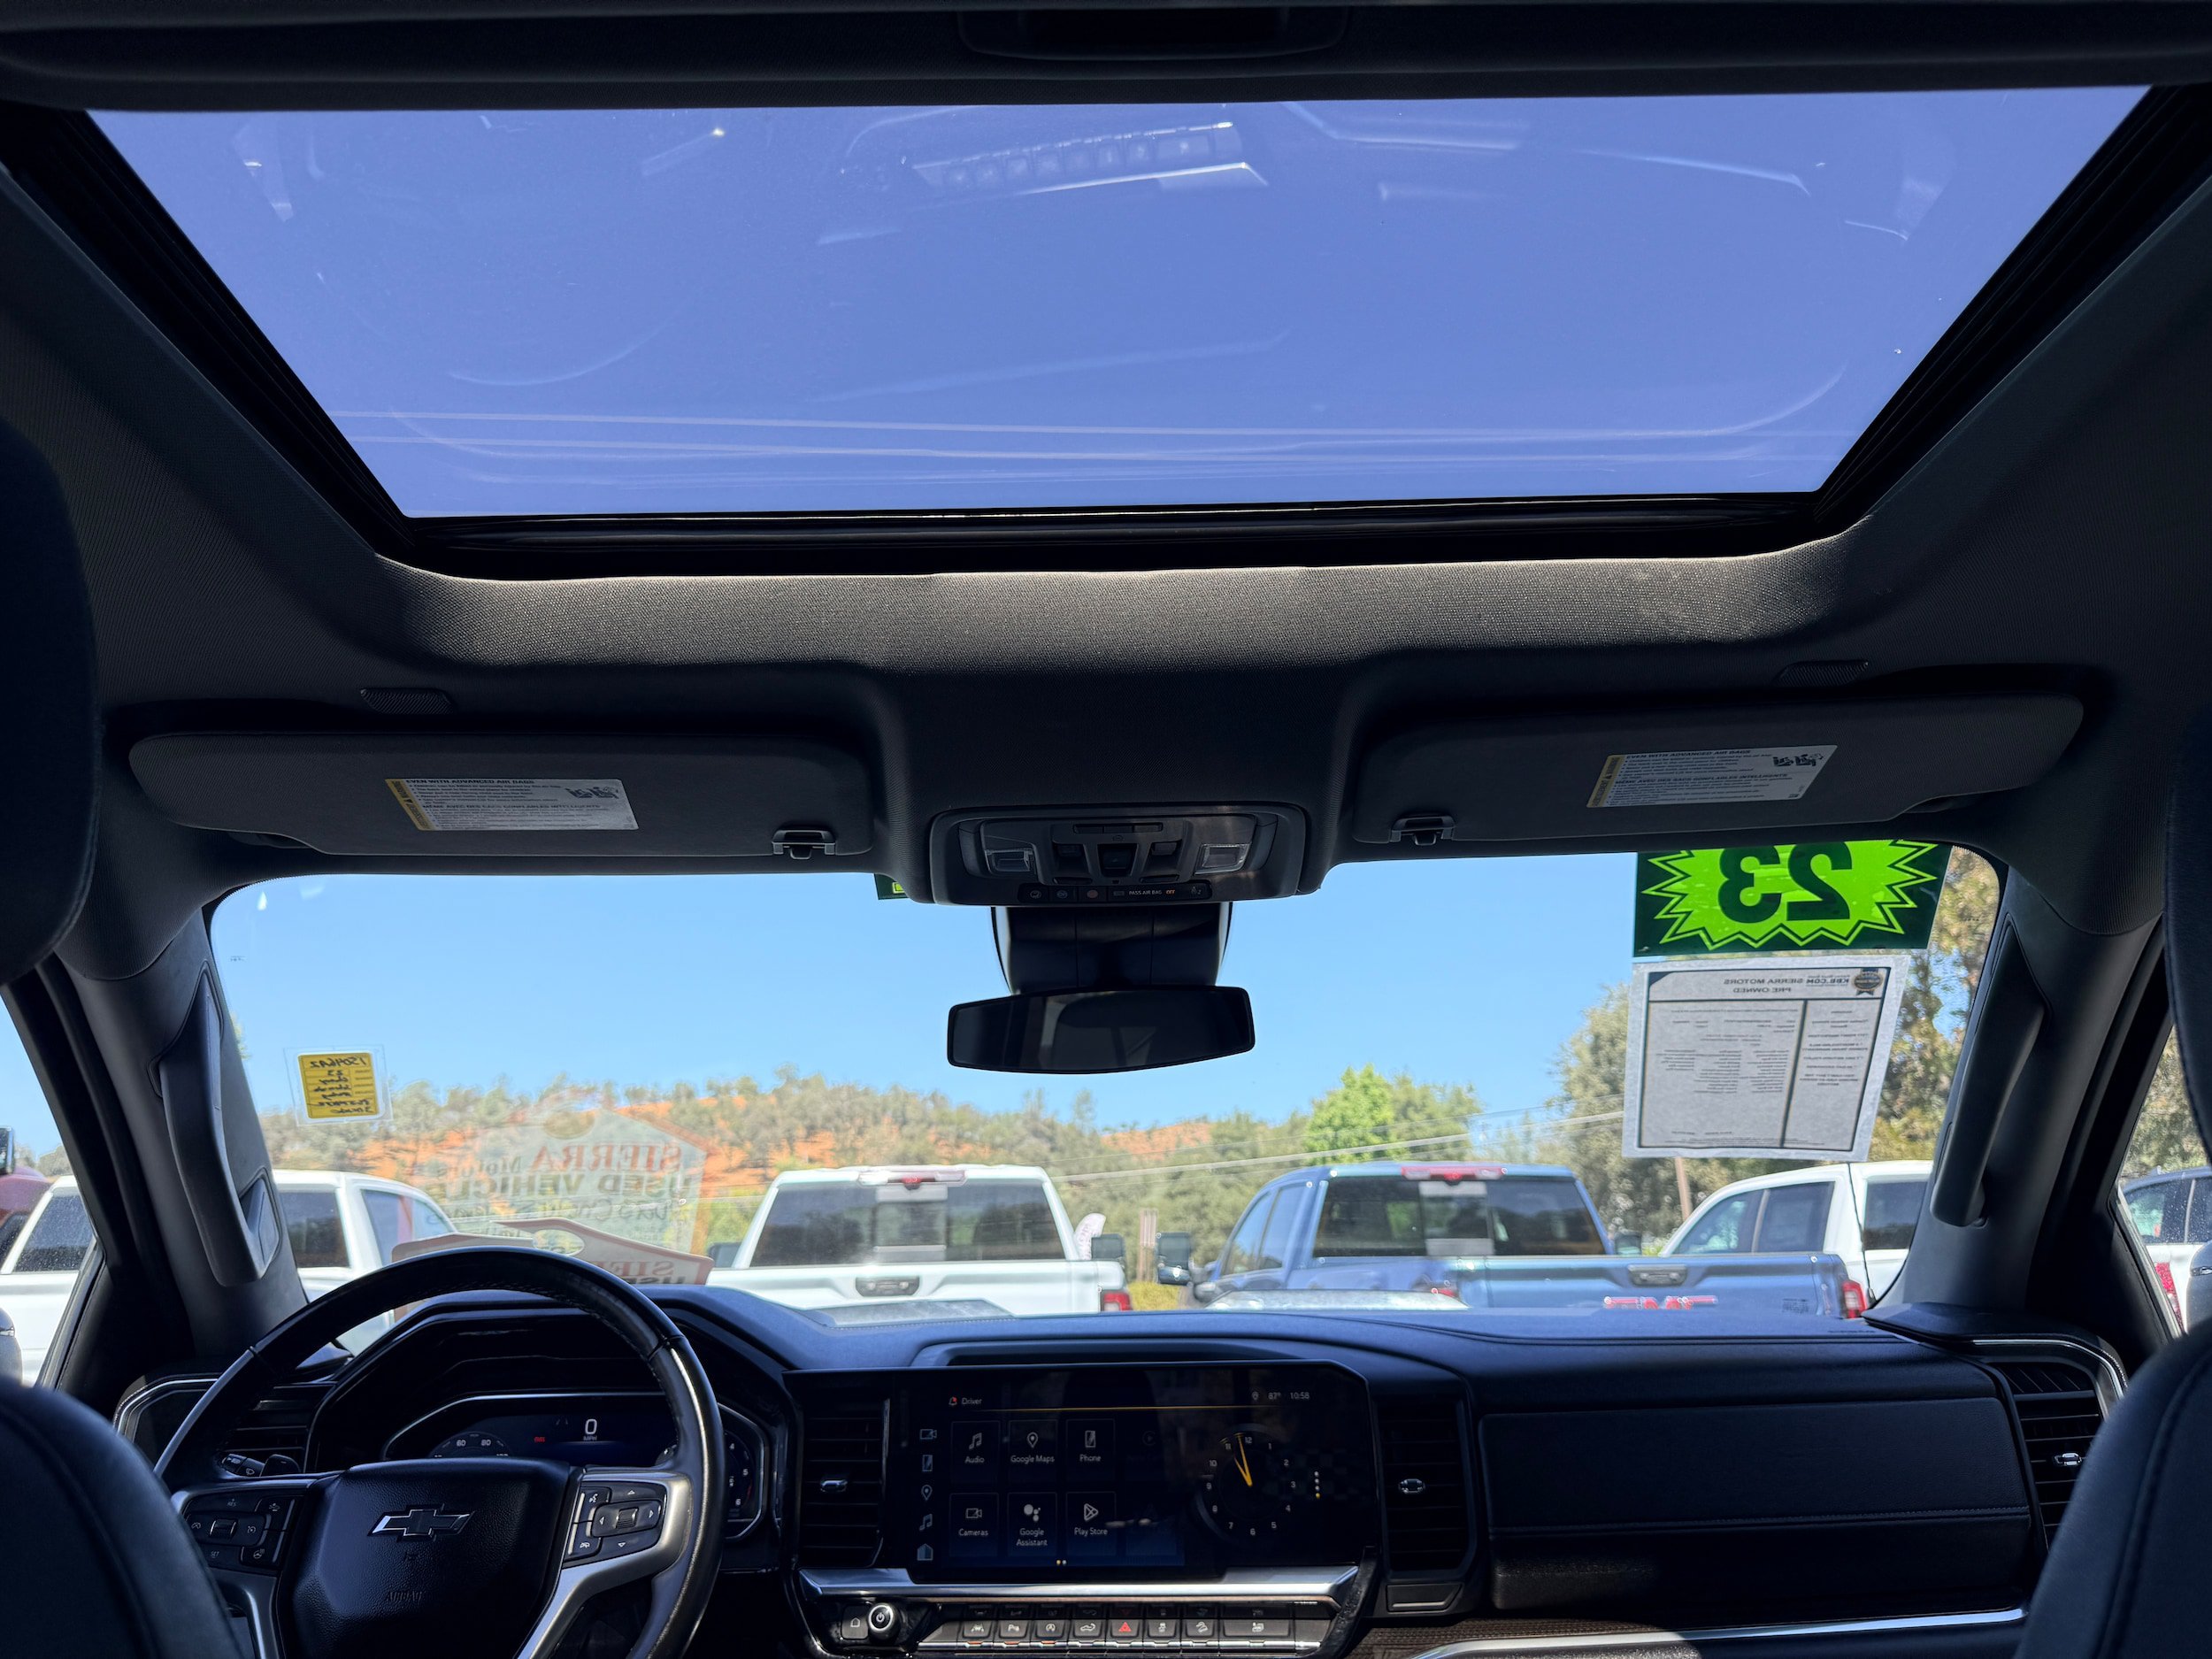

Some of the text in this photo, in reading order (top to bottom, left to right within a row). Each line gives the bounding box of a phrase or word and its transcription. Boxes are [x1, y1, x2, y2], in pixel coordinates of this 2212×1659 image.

[961, 1396, 984, 1406] Driver
[584, 1418, 598, 1435] 0
[964, 1455, 986, 1465] Audio
[1010, 1454, 1056, 1468] Google Maps
[1079, 1453, 1102, 1463] Phone
[1271, 1521, 1278, 1530] 5
[958, 1527, 989, 1537] Cameras
[1019, 1527, 1045, 1539] Google
[1074, 1526, 1109, 1539] Play Store
[1249, 1527, 1256, 1536] 6
[1016, 1538, 1048, 1548] Assistant
